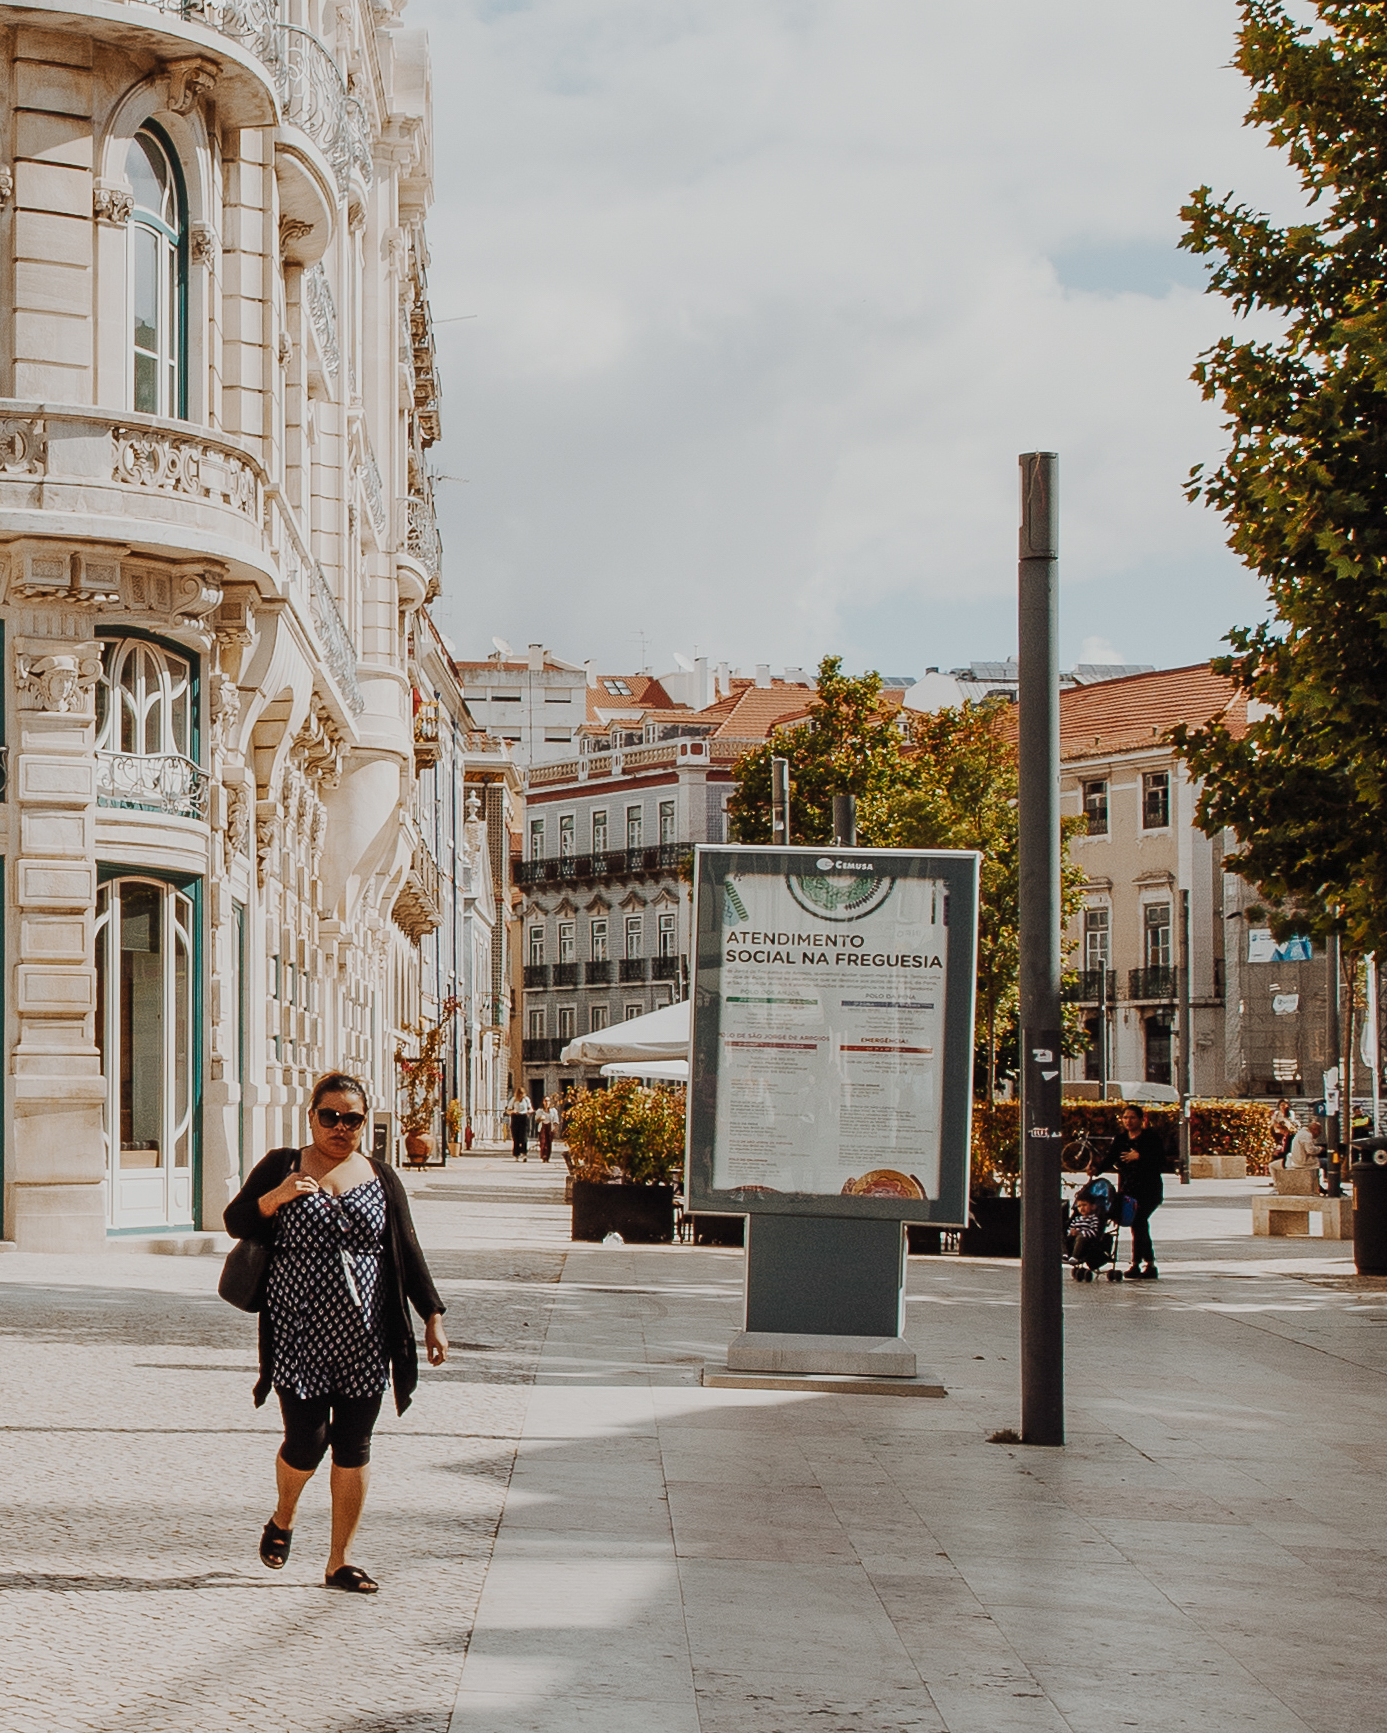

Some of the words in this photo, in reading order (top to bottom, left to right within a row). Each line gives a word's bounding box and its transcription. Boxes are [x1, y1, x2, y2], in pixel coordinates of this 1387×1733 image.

[726, 931, 864, 949] ATENDIMENTO
[725, 949, 796, 964] SOCIAL
[801, 951, 829, 966] NA
[835, 952, 943, 969] FREGUESIA
